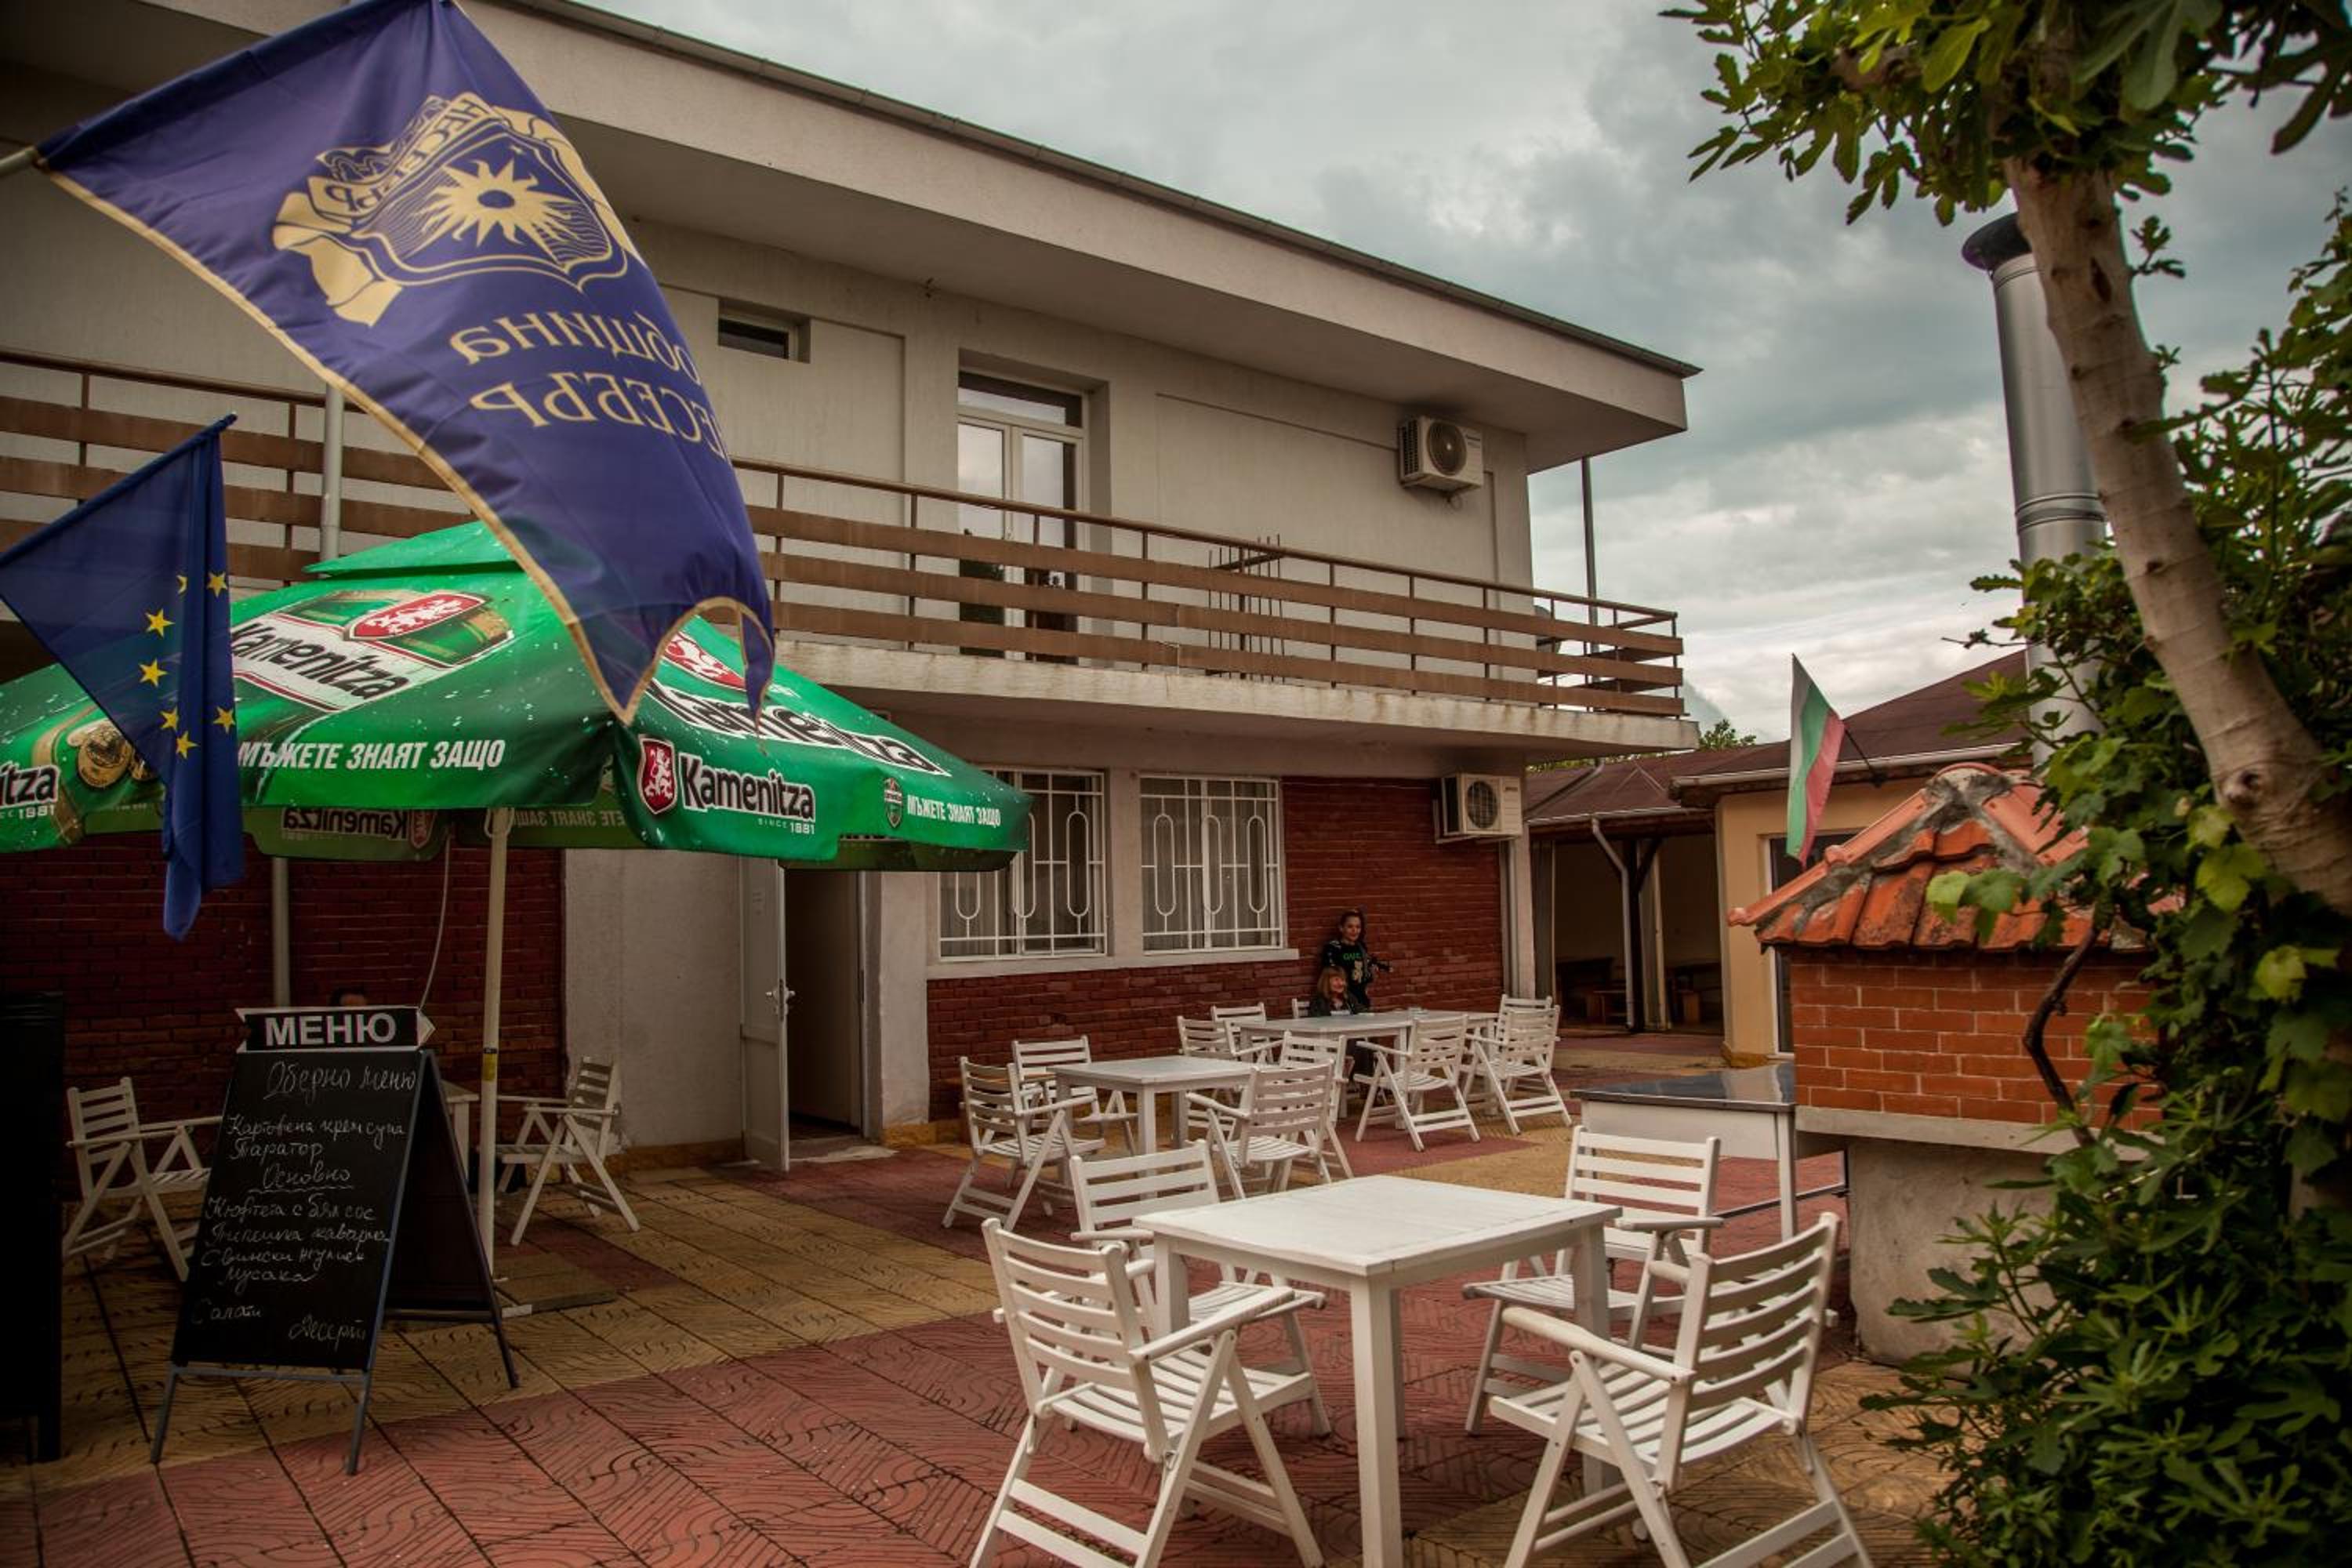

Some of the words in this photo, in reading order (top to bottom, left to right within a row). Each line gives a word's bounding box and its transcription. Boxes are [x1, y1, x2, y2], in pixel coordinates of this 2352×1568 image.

[238, 741, 343, 768] МЪЖЕТЕ
[346, 742, 428, 769] ЗНАЯТ
[430, 739, 505, 771] ЗАЩО
[679, 753, 815, 820] Kamenitza
[18, 805, 55, 819] 1881
[757, 818, 787, 828] SINCE
[789, 822, 815, 834] 1881
[907, 794, 946, 820] МЪЖЕТЕ
[947, 802, 975, 824] ЗНАЯТ
[976, 807, 1001, 828] ЗАЩО
[265, 1012, 397, 1047] МЕНЮ
[292, 1204, 303, 1216] с
